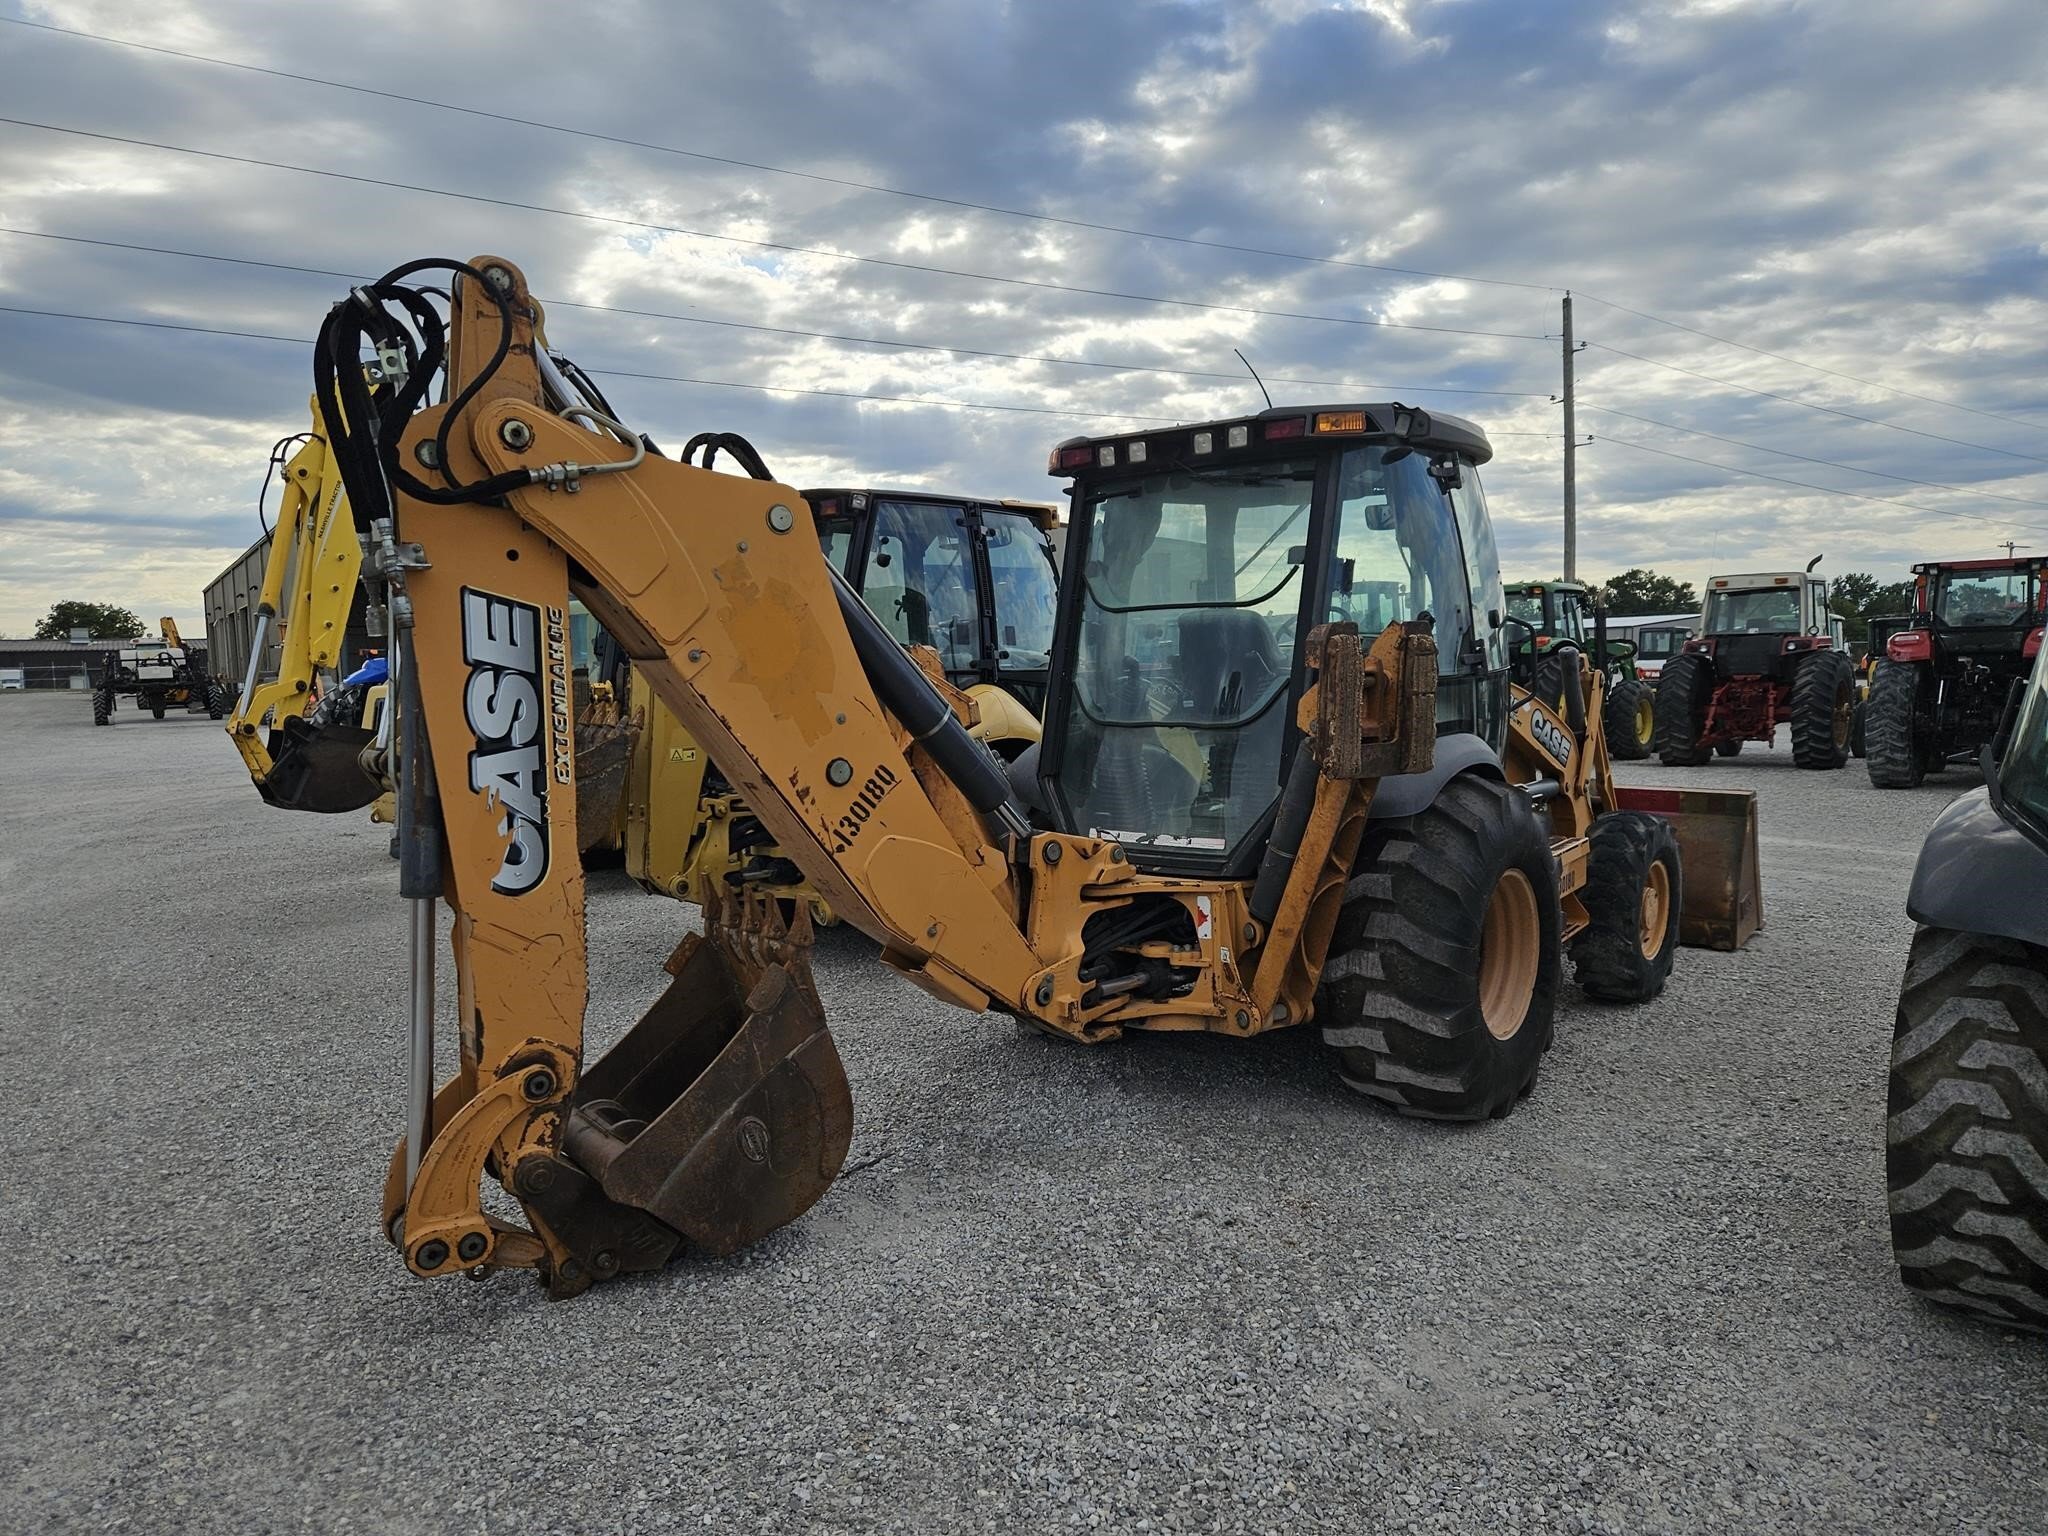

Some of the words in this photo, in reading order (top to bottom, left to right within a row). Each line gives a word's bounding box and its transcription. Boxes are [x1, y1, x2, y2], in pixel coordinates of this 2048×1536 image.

[318, 506, 333, 538] NASHVILLE
[329, 480, 342, 507] TRACTOR
[459, 586, 551, 896] CASE
[547, 605, 571, 785] EXTENDAHOE
[1531, 708, 1572, 768] CASE
